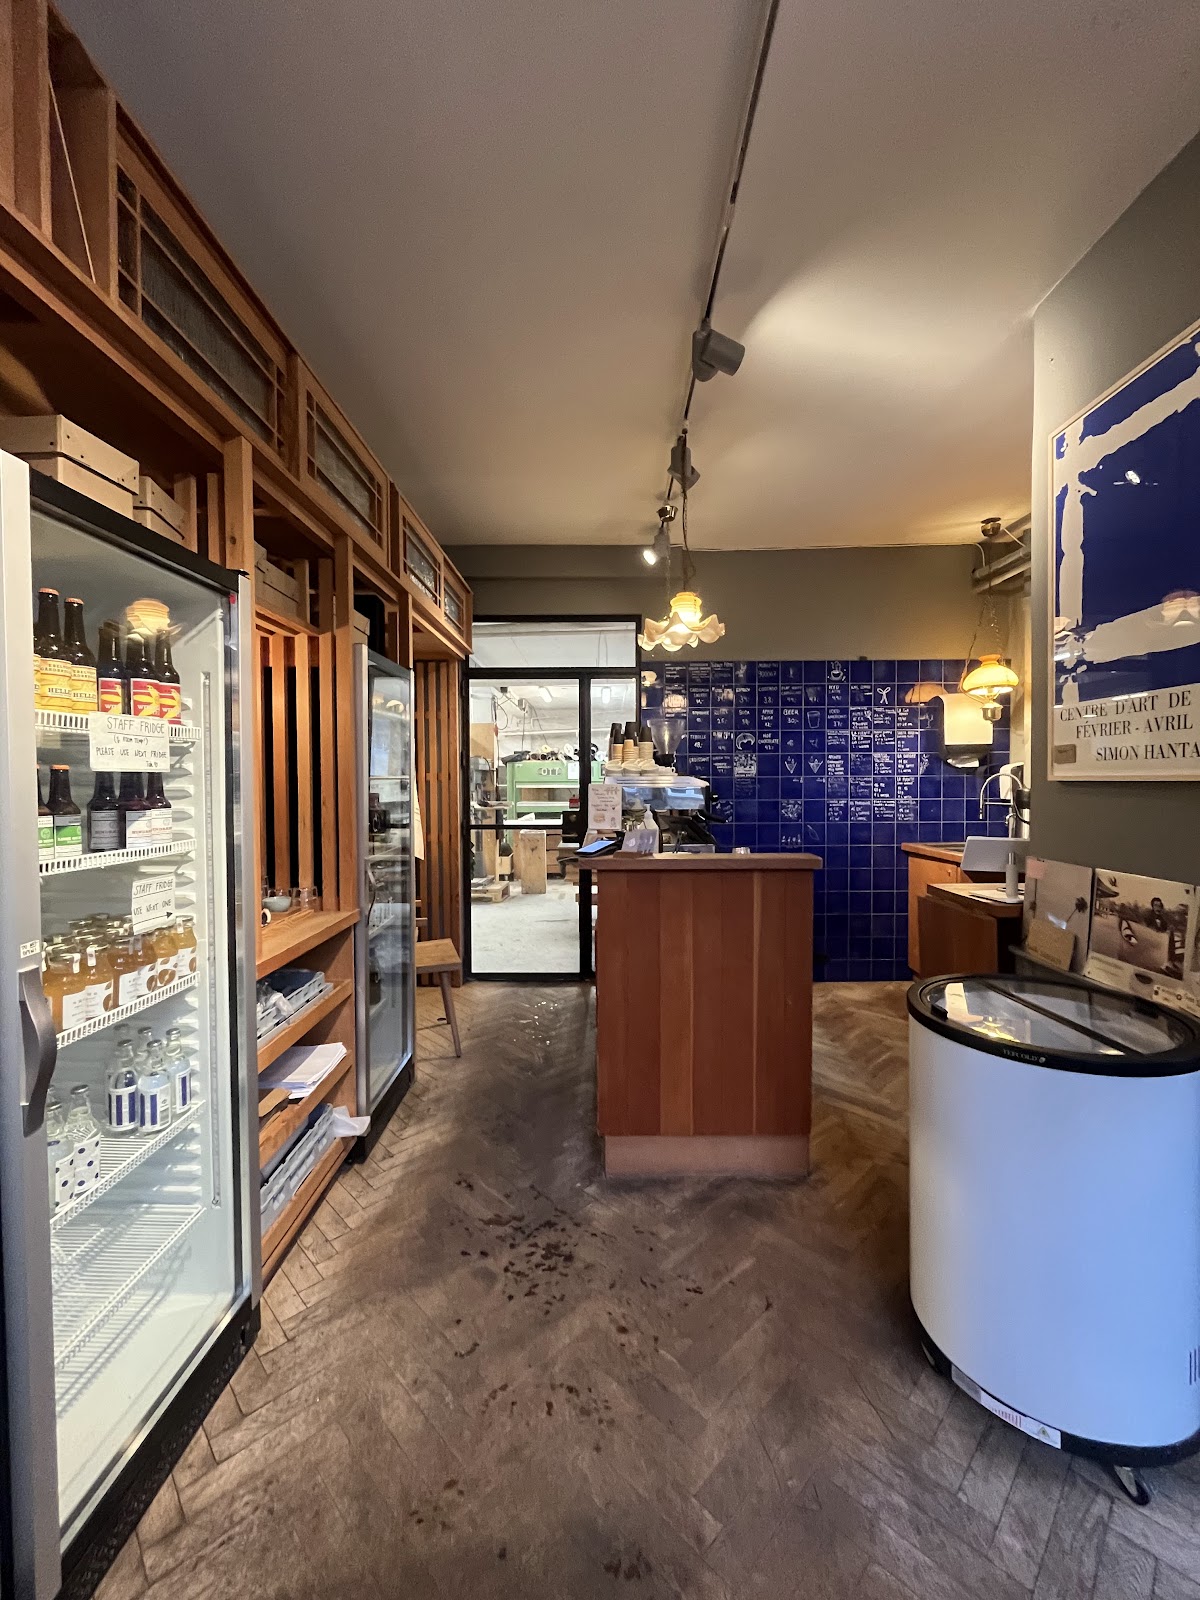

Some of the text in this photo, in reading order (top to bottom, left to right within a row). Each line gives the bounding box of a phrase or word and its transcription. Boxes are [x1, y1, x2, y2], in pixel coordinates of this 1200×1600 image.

[1060, 690, 1191, 722] CENTRE D'ART DE
[106, 717, 165, 734] STAFF FRIDGE
[1076, 720, 1131, 739] FÉVRIER
[1144, 714, 1194, 733] AVRIL
[96, 746, 114, 756] PLEASE
[134, 750, 147, 758] NEXT
[1096, 745, 1139, 762] SIMON
[134, 879, 174, 896] STAFF FRIDGE
[134, 899, 172, 916] USE NEXT ONE
